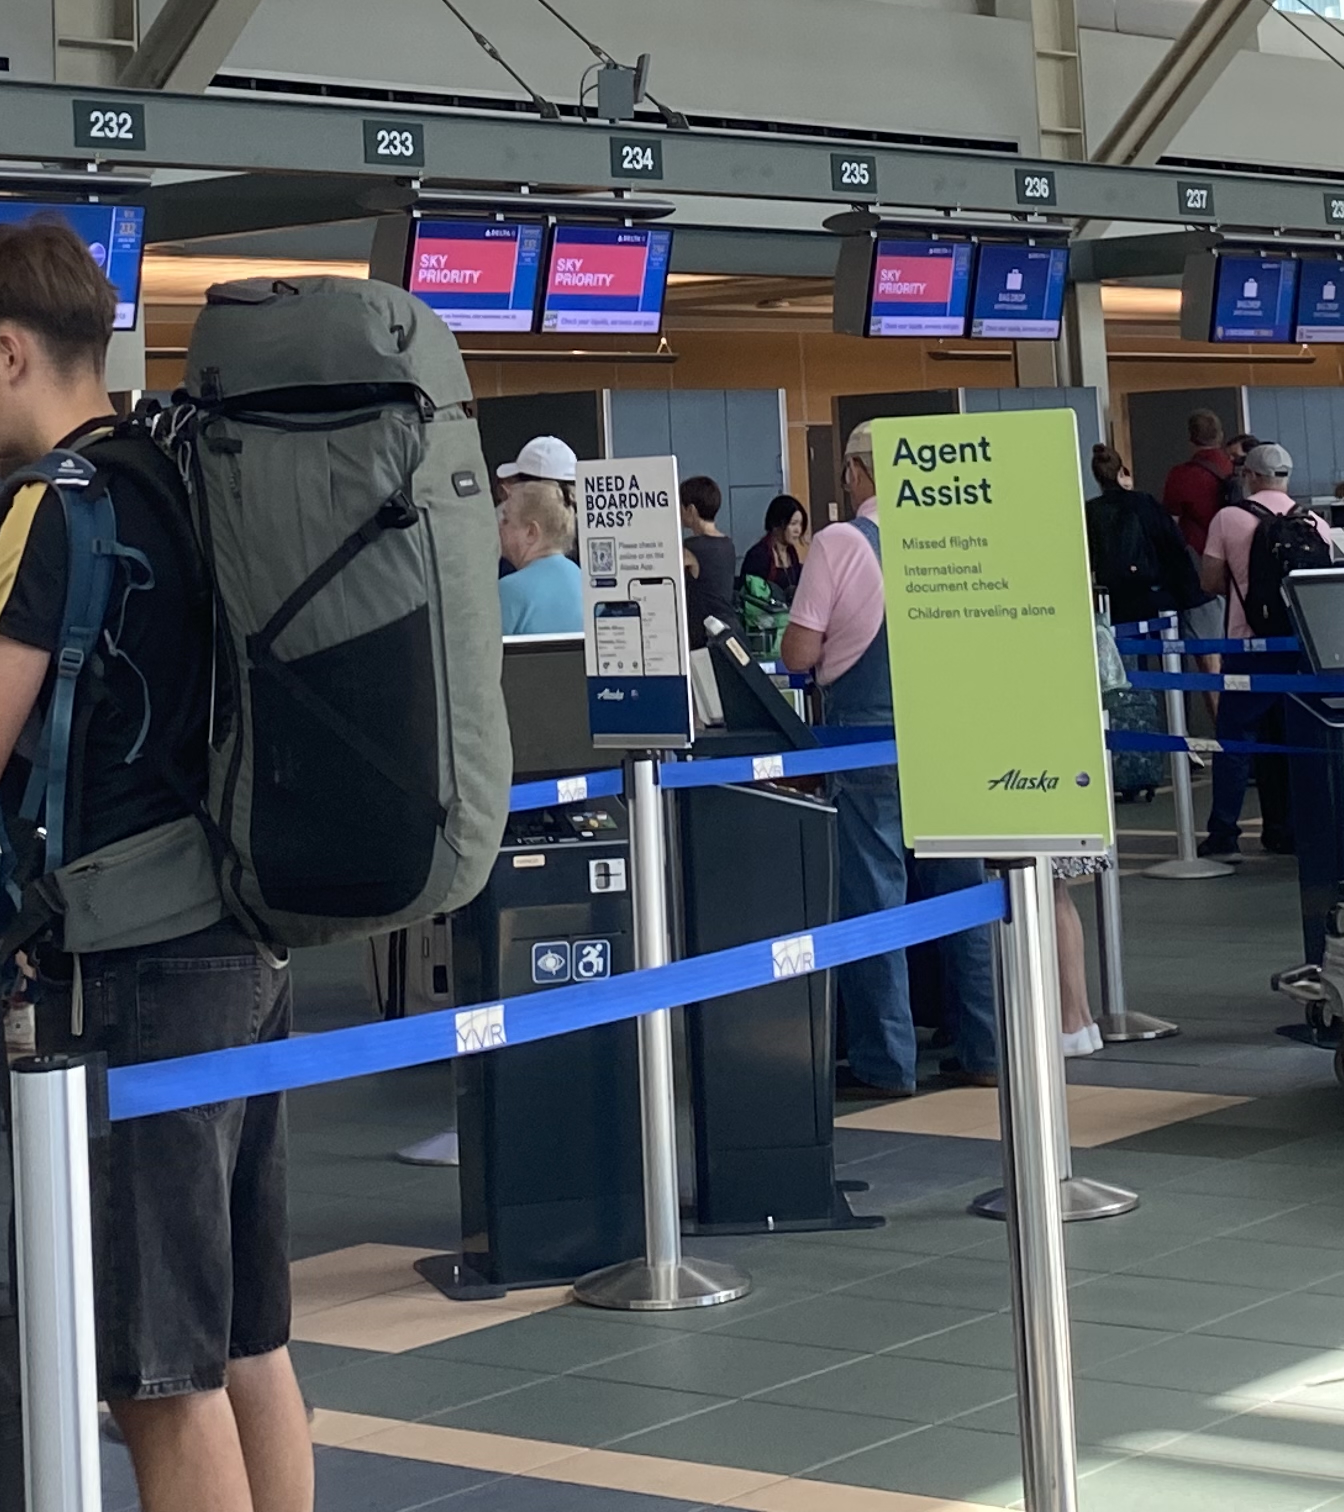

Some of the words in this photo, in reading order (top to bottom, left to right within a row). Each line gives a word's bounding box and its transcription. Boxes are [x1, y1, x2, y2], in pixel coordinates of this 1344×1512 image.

[90, 112, 133, 139] 232
[377, 130, 414, 156] 233
[622, 146, 654, 170] 234
[842, 162, 870, 185] 235
[1025, 177, 1049, 198] 236
[1186, 189, 1207, 208] 237
[419, 254, 448, 268] SKY
[557, 258, 583, 272] SKY
[418, 270, 482, 284] PRIORITY
[555, 273, 614, 287] PRIORITY
[881, 269, 902, 281] SKY
[879, 283, 927, 295] PRIORITY
[893, 435, 992, 472] Agent
[584, 475, 624, 493] NEED
[629, 474, 641, 491] A
[896, 476, 992, 508] Assist
[586, 491, 669, 510] BOARDING
[587, 511, 633, 528] PASS?
[902, 537, 946, 550] Missed
[949, 536, 988, 551] flights
[904, 563, 982, 576] International
[906, 579, 968, 593] document
[971, 578, 1008, 591] check
[908, 605, 960, 620] Children
[963, 605, 1017, 620] traveling
[1021, 605, 1055, 617] alone
[754, 766, 782, 779] YVR
[988, 769, 1060, 792] Alaska
[558, 788, 586, 801] YVR
[773, 952, 813, 977] YVR
[456, 1024, 506, 1051] YVR
